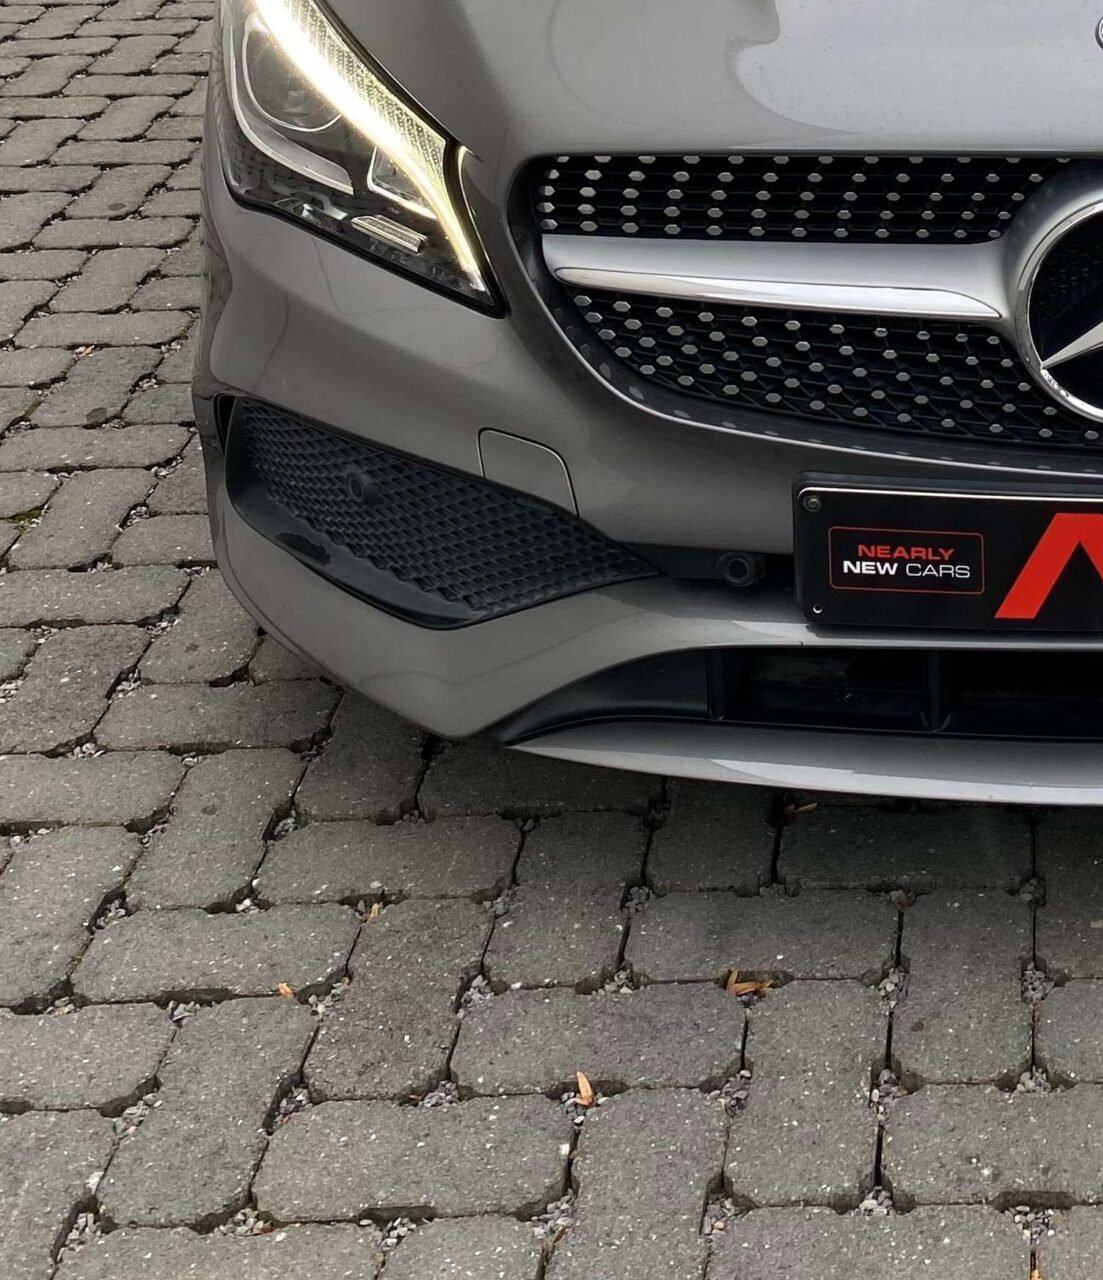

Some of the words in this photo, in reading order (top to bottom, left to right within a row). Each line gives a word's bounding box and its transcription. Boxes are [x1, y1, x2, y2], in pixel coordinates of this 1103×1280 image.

[857, 544, 955, 561] NEARLY
[842, 560, 899, 576] NEW
[905, 563, 971, 579] CARS
